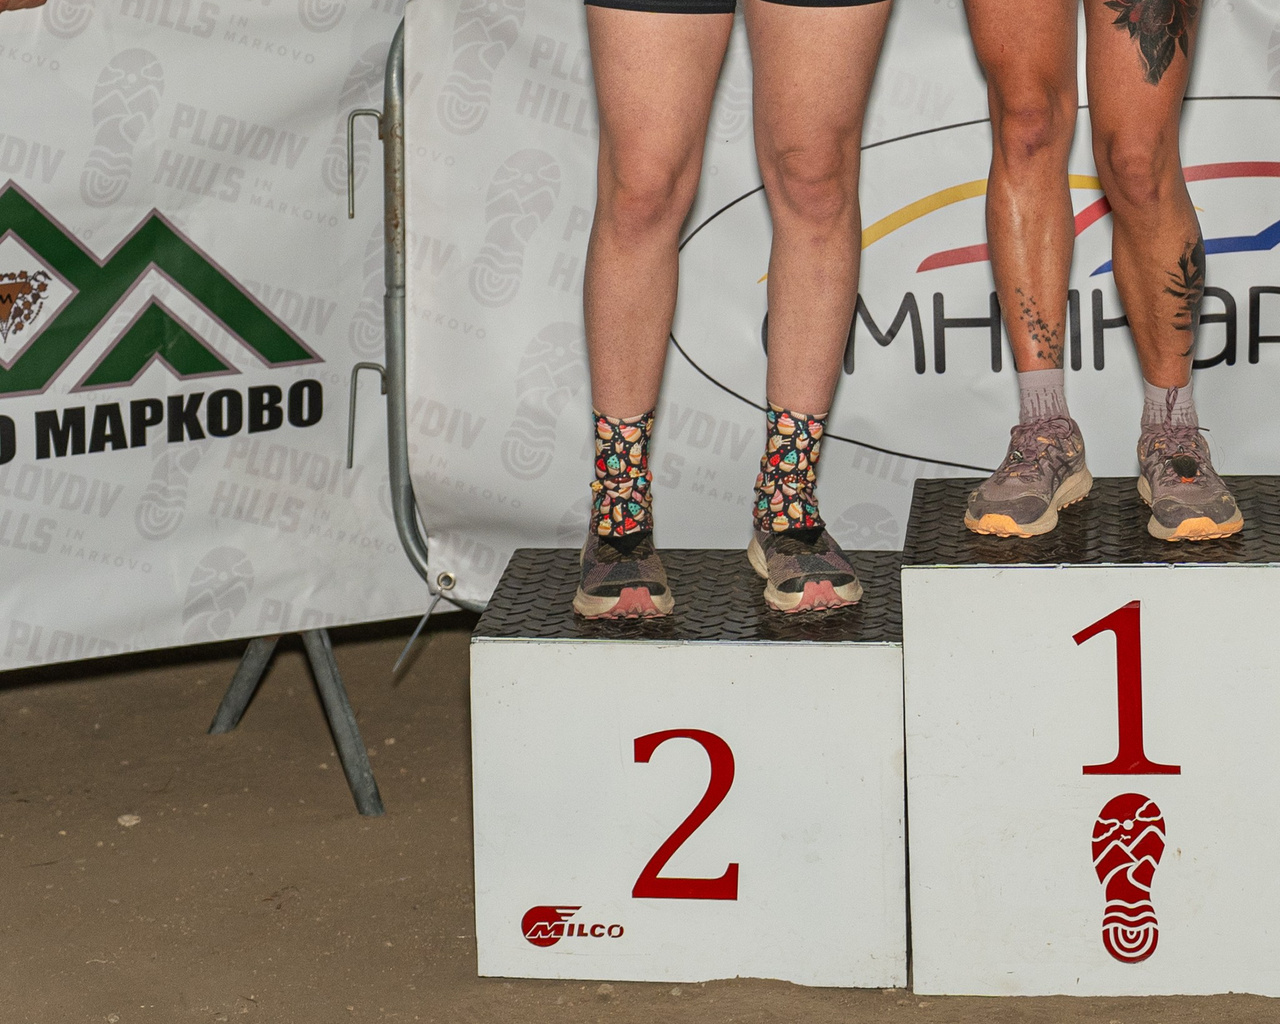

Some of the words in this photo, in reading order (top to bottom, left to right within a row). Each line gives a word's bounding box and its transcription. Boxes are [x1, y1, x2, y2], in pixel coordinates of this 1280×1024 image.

[228, 14, 249, 29] IN
[223, 31, 315, 64] MARKOVO
[169, 102, 310, 169] PLOVDIV
[152, 149, 246, 203] HILLS
[254, 177, 273, 193] IN
[249, 194, 338, 228] MARKOVO
[34, 378, 324, 460] МАРКОВО
[223, 436, 365, 499] PLOVDIV
[696, 466, 717, 481] IN
[208, 480, 306, 533] HILLS
[66, 527, 85, 542] IN
[60, 544, 152, 573] MARKOVO
[1071, 600, 1181, 776] 1
[632, 728, 739, 901] 2
